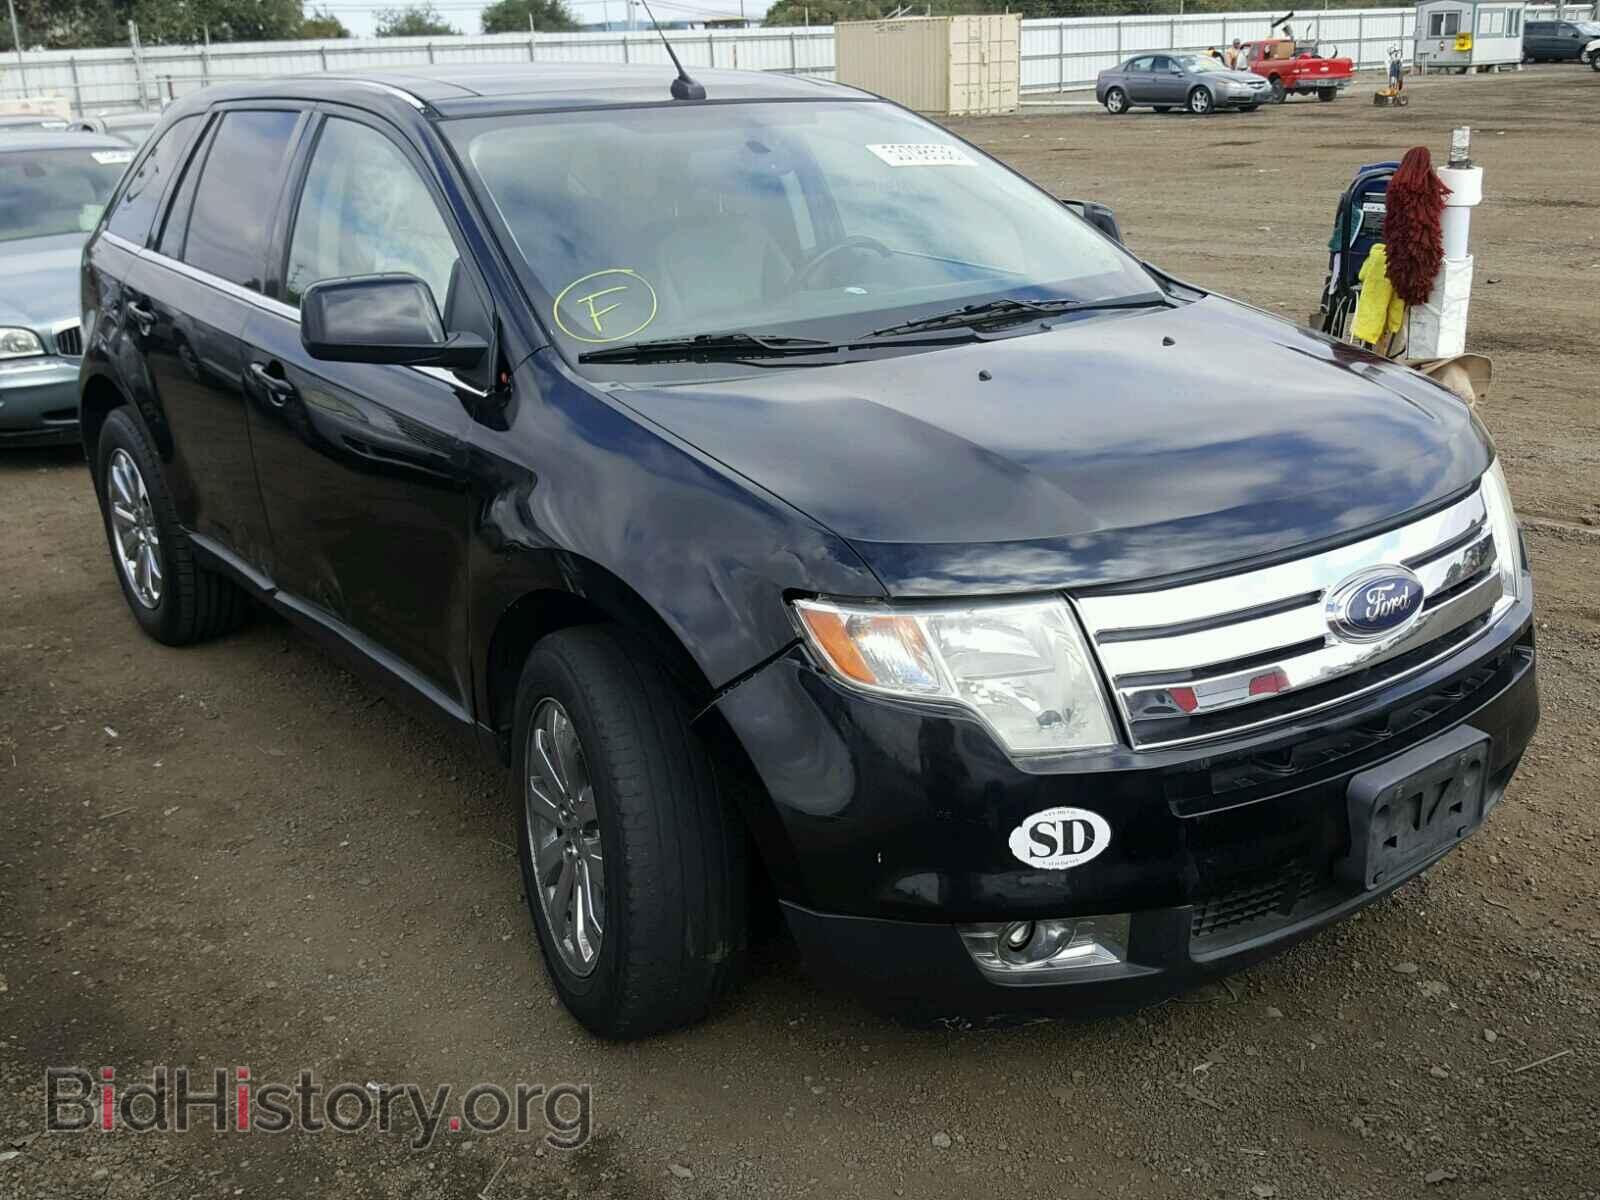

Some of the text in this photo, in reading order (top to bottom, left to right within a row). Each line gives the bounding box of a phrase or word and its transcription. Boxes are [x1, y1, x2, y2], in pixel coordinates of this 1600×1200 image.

[576, 286, 628, 333] F
[1366, 583, 1411, 620] Ford
[1029, 819, 1096, 858] SD
